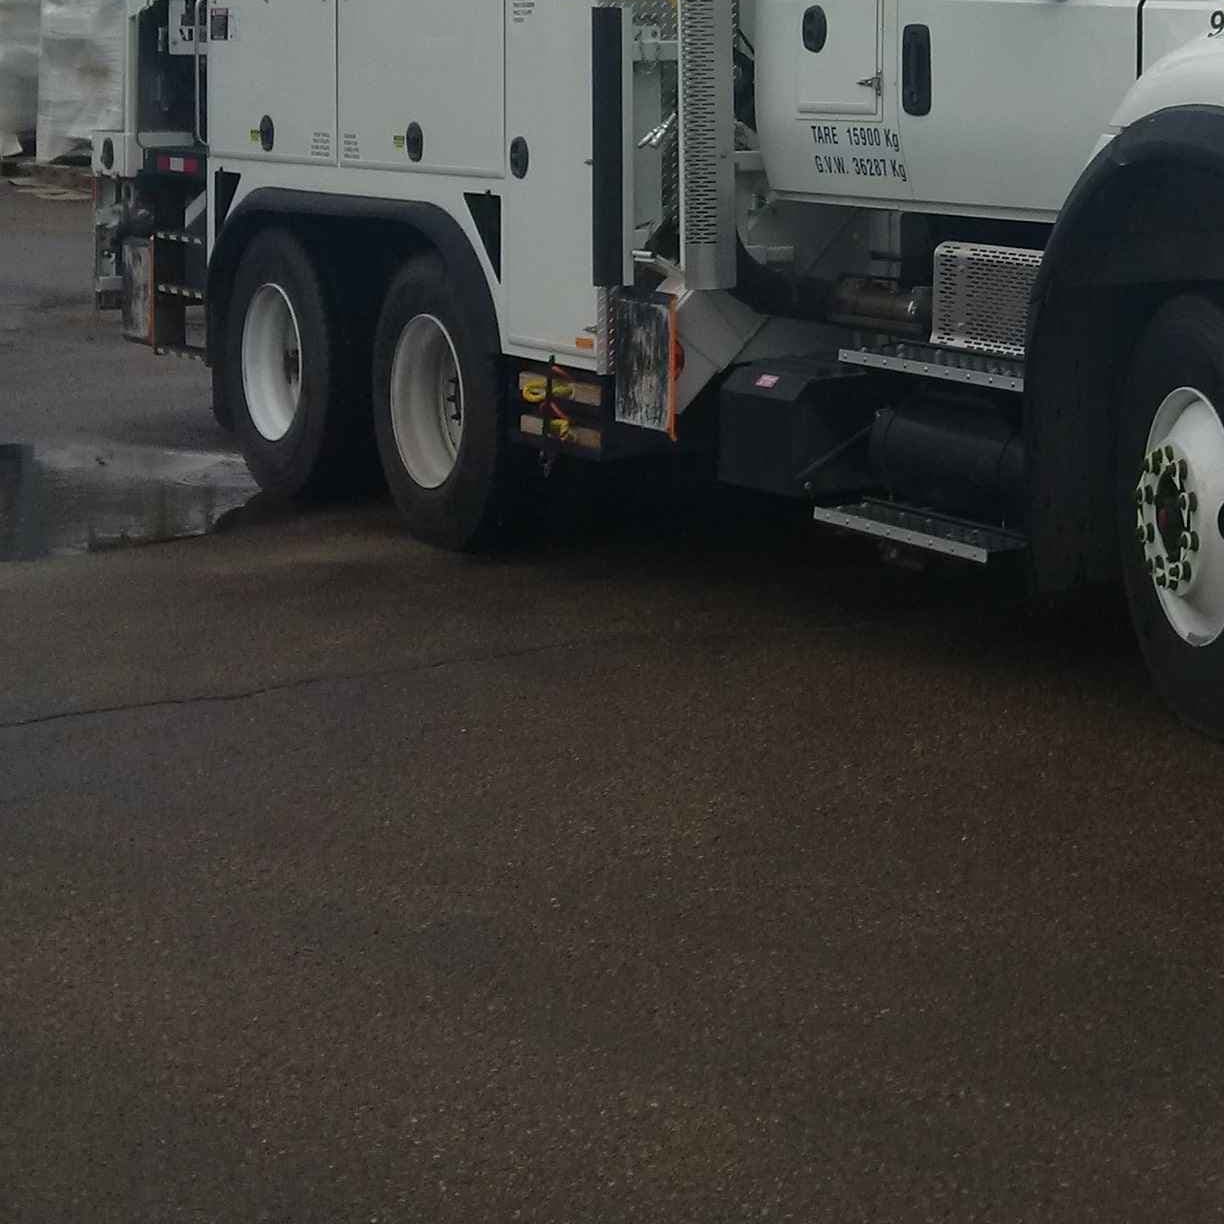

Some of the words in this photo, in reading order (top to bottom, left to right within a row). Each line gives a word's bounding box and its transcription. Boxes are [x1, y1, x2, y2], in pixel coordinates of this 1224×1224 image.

[811, 126, 838, 145] TARE
[846, 128, 881, 147] 15900
[884, 129, 900, 152] Kg
[852, 157, 887, 177] 36287
[891, 160, 907, 182] Kg
